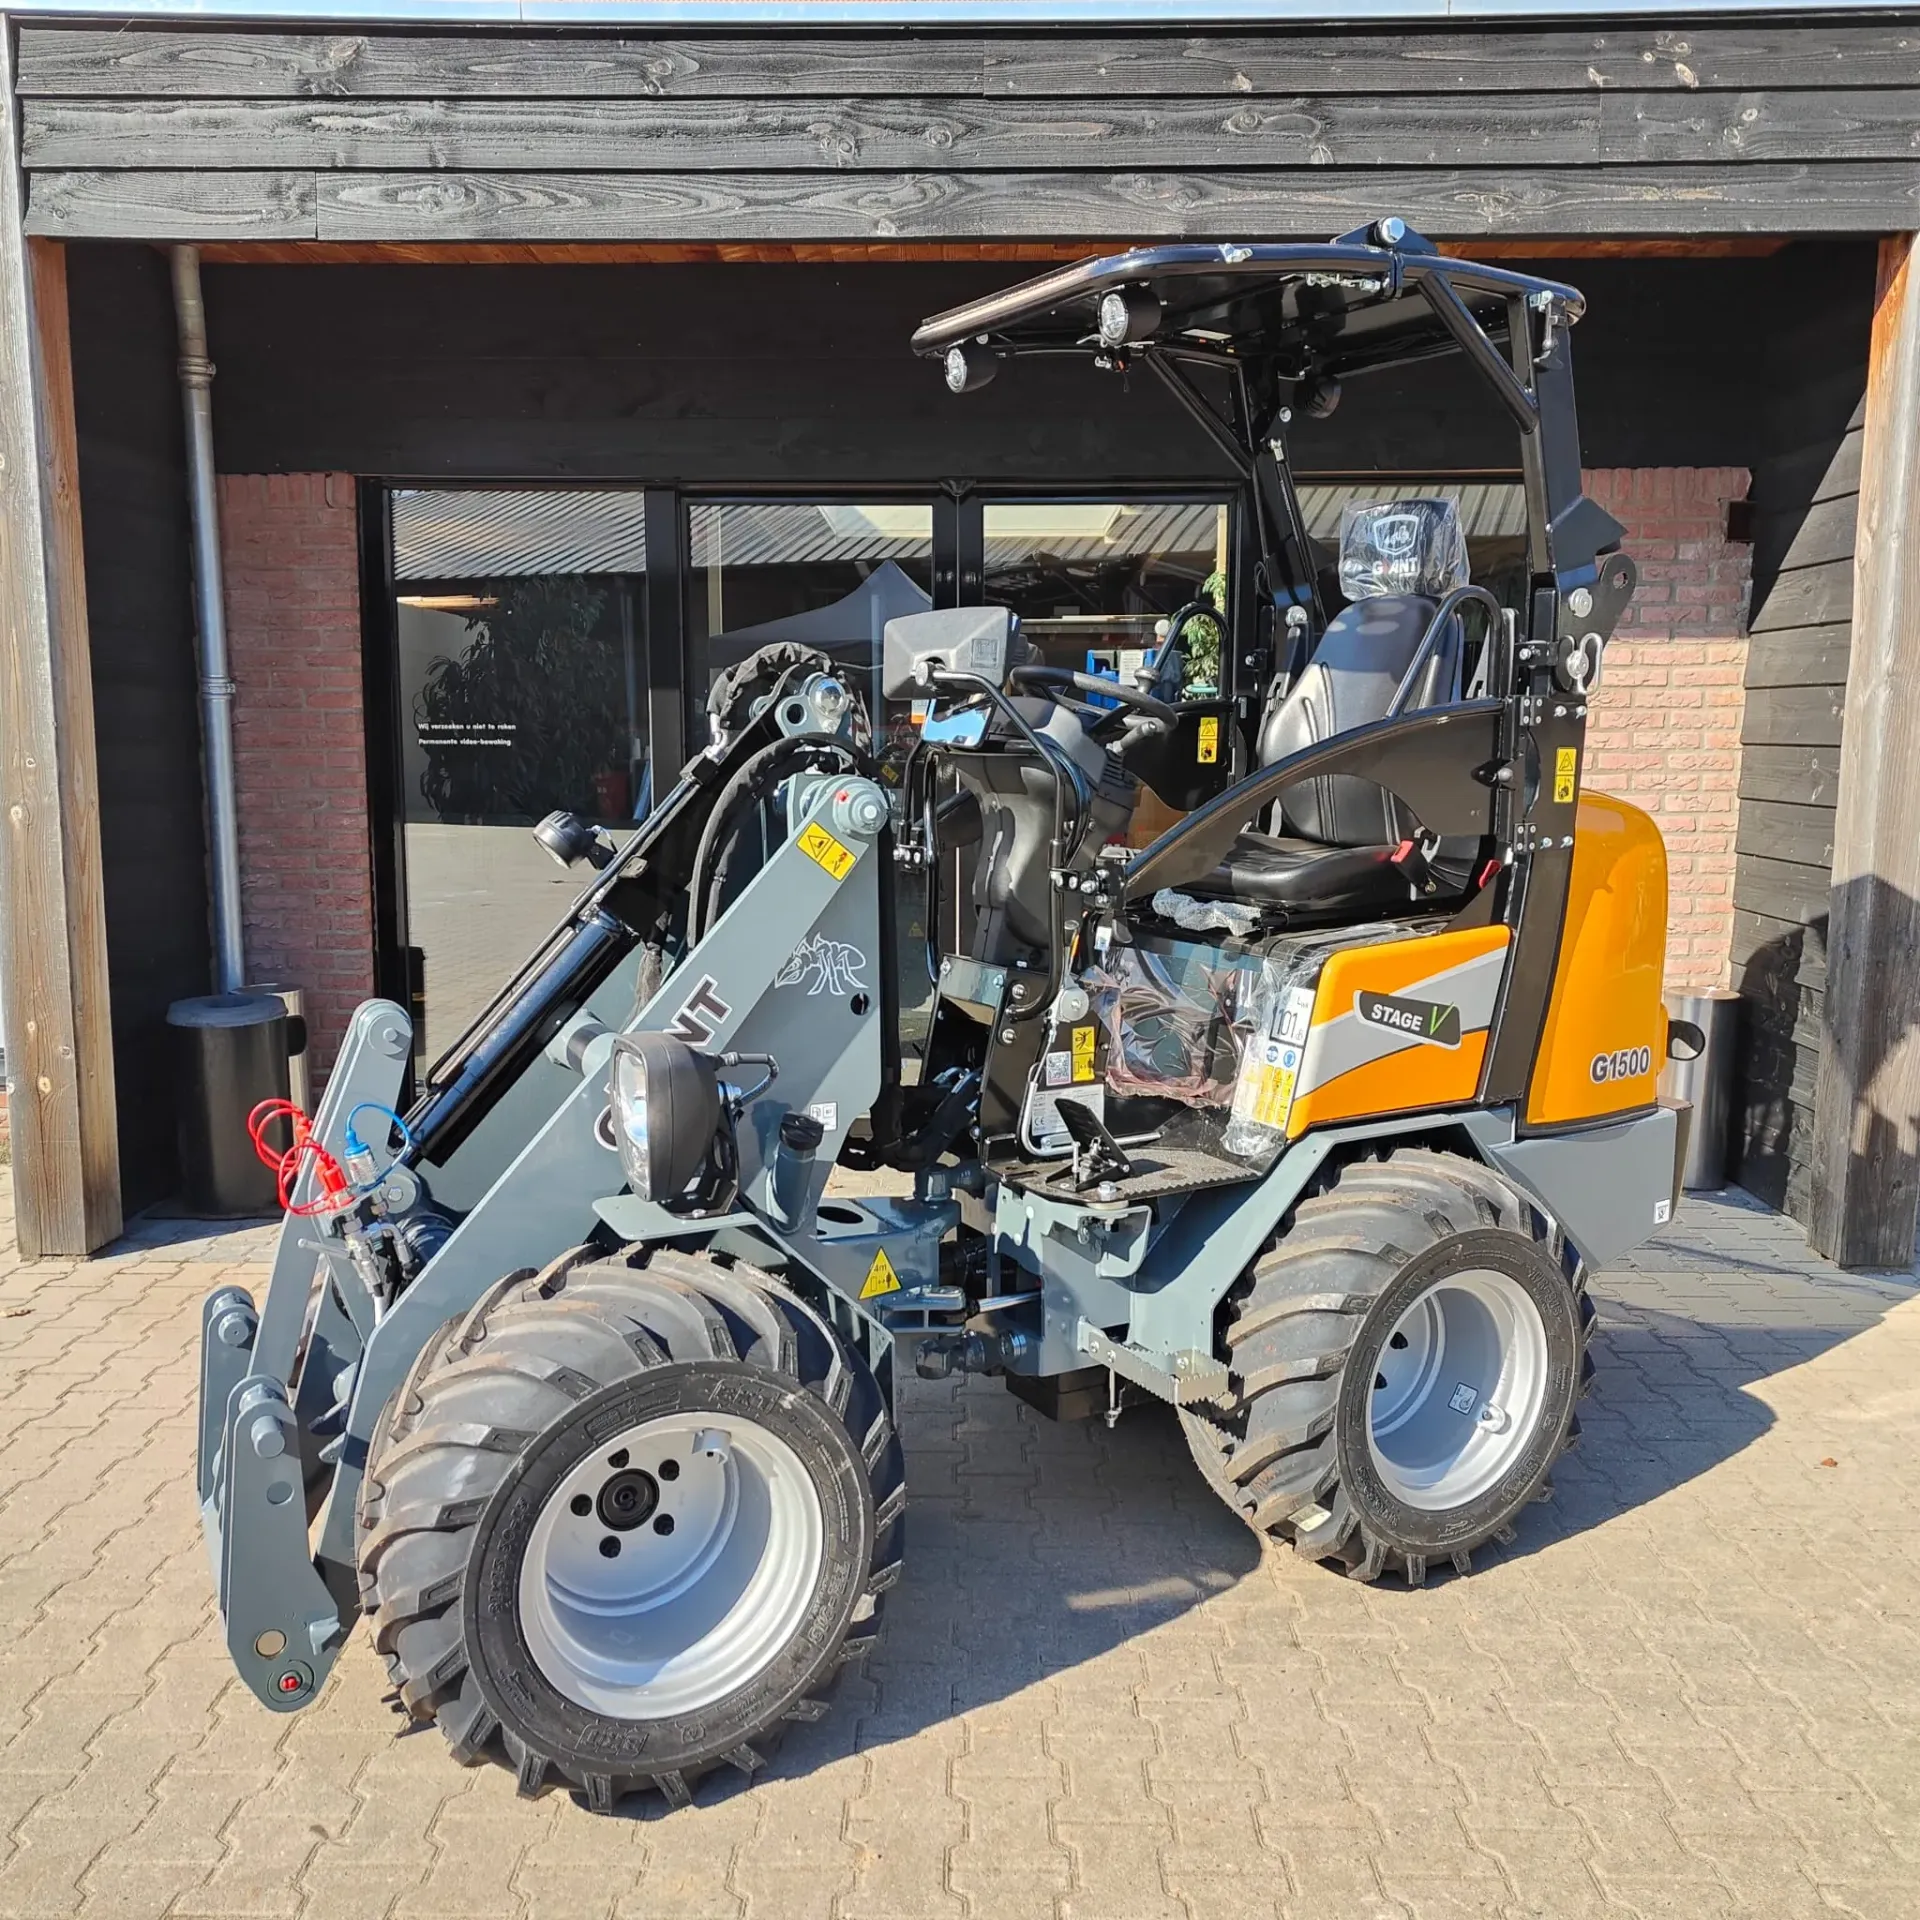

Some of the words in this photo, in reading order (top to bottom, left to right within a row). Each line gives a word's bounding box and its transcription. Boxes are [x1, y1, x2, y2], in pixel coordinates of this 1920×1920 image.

[418, 723, 429, 731] Wij
[1277, 1009, 1298, 1039] 101
[1371, 1003, 1424, 1032] STAGE
[1429, 1002, 1455, 1036] V
[1591, 1045, 1650, 1083] G1500
